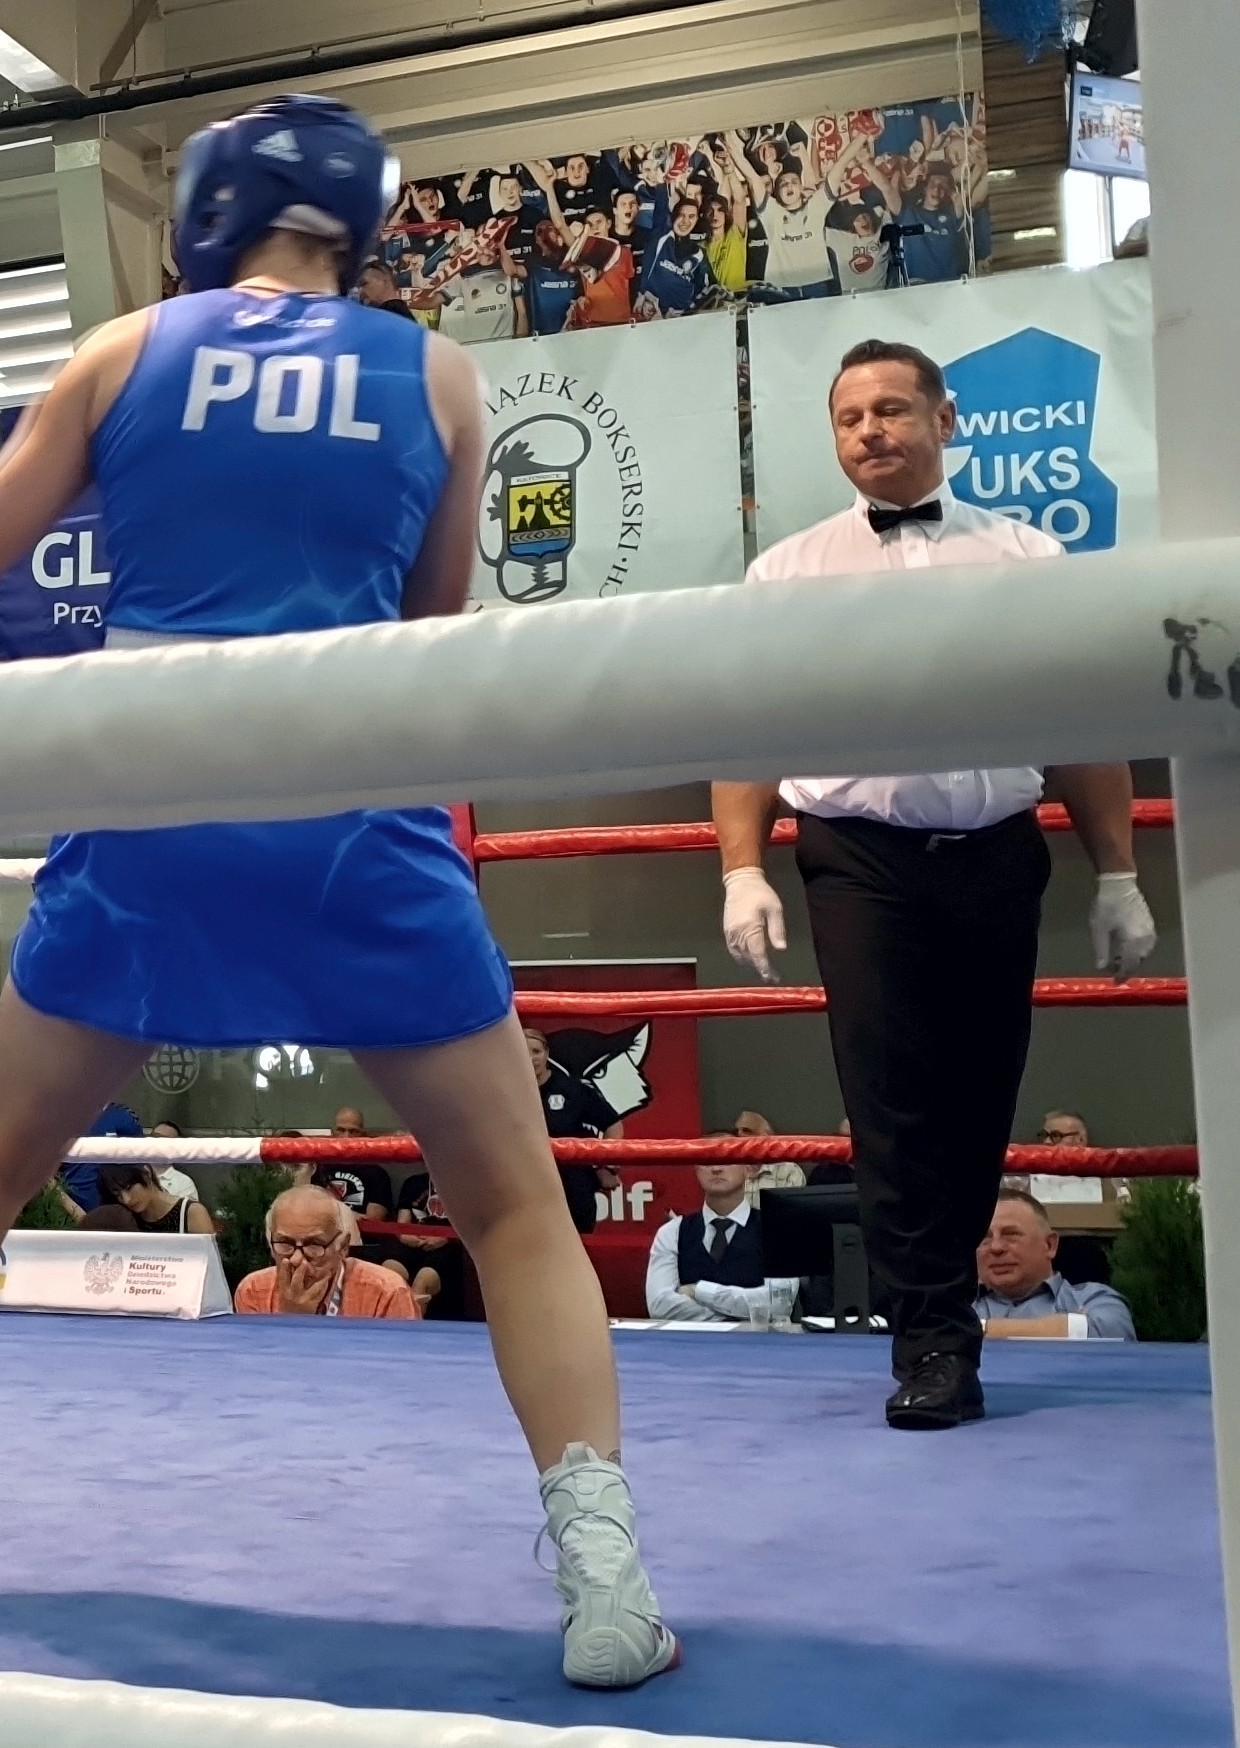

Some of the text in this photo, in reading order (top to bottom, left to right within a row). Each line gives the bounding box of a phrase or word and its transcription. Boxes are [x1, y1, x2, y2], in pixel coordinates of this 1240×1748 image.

[181, 345, 381, 442] POL
[956, 400, 1086, 438] WICKI
[484, 372, 644, 552] IĄZEK BOKSERSKI
[971, 446, 1081, 499] UKS
[31, 531, 111, 589] GL
[53, 603, 103, 628] Przy
[129, 1262, 166, 1272] Kultury
